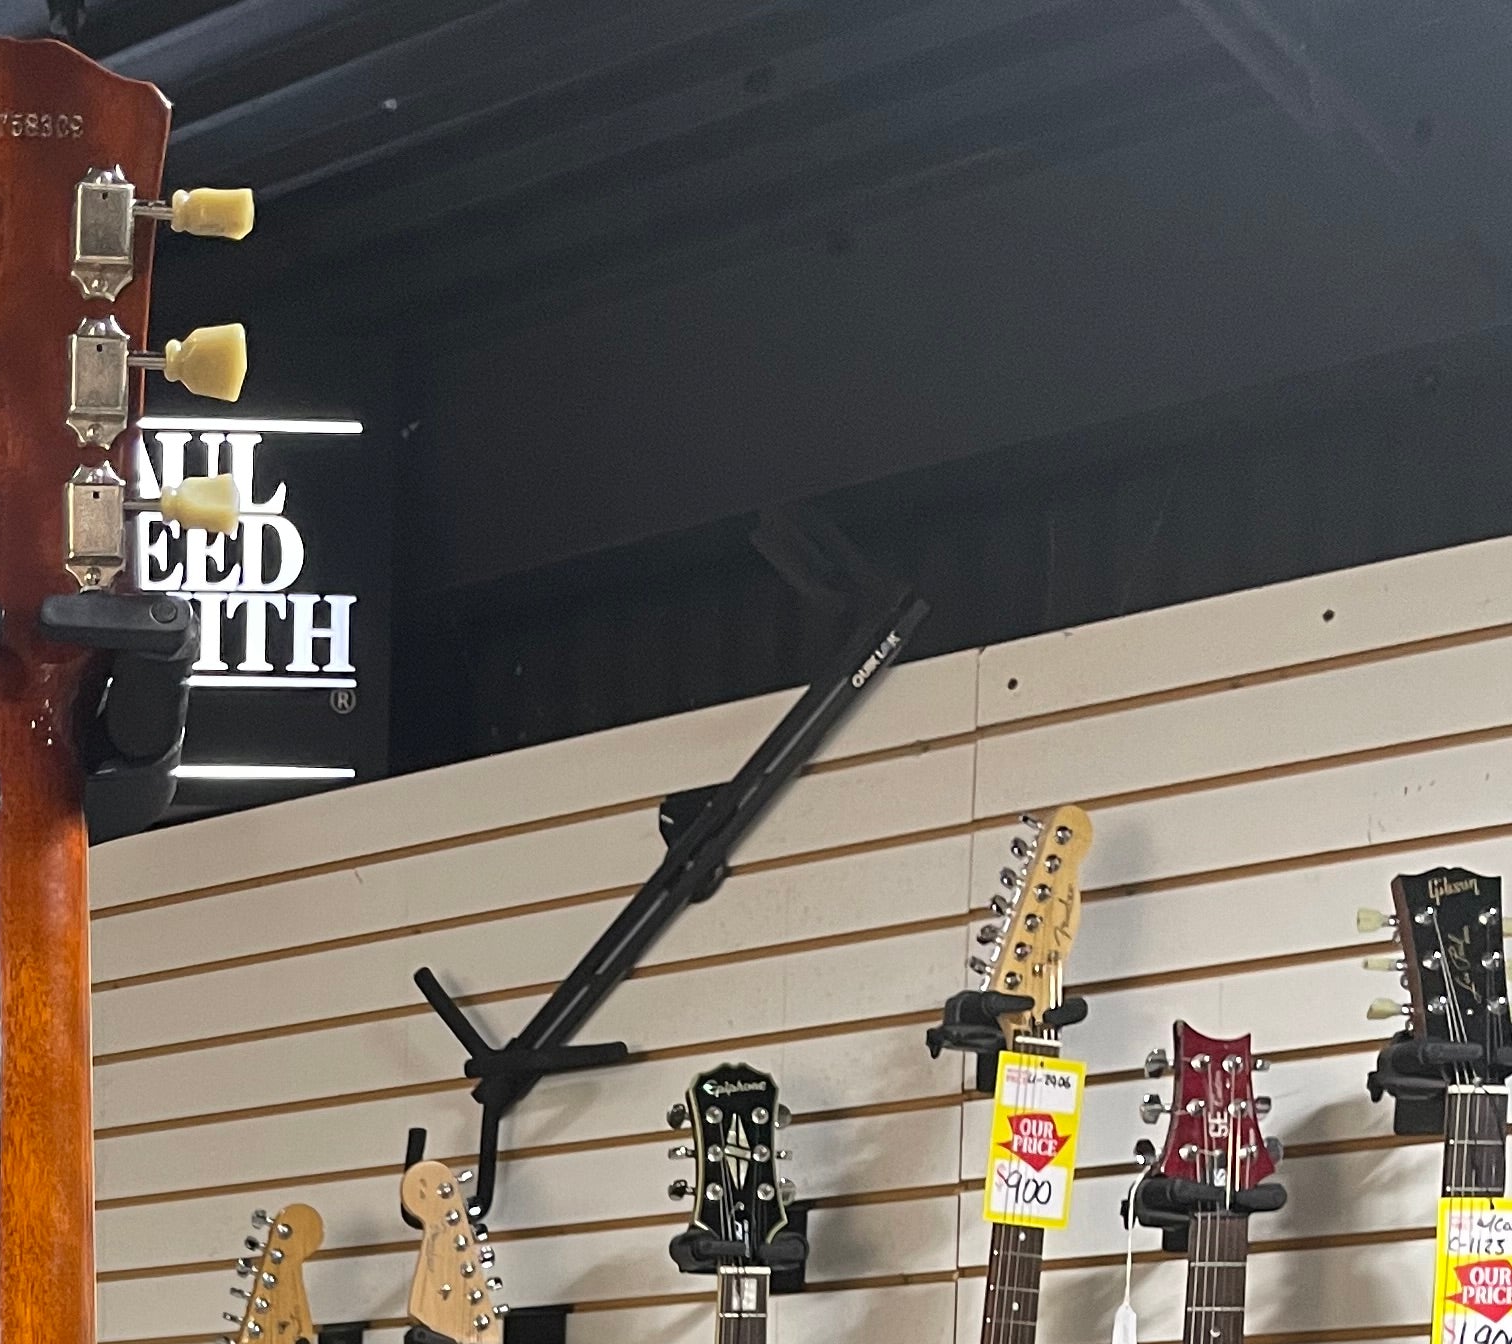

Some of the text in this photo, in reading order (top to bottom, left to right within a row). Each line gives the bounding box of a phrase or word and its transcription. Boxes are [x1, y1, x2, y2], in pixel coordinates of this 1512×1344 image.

[138, 511, 305, 592] EED
[166, 592, 357, 673] ITH
[1428, 877, 1480, 906] Gibson
[703, 1080, 767, 1098] Epiphone
[1020, 1118, 1054, 1139] OUR
[1208, 1111, 1229, 1138] SE
[1012, 1133, 1059, 1156] PRICE
[995, 1163, 1052, 1205] $900
[1469, 1266, 1512, 1287] OUR
